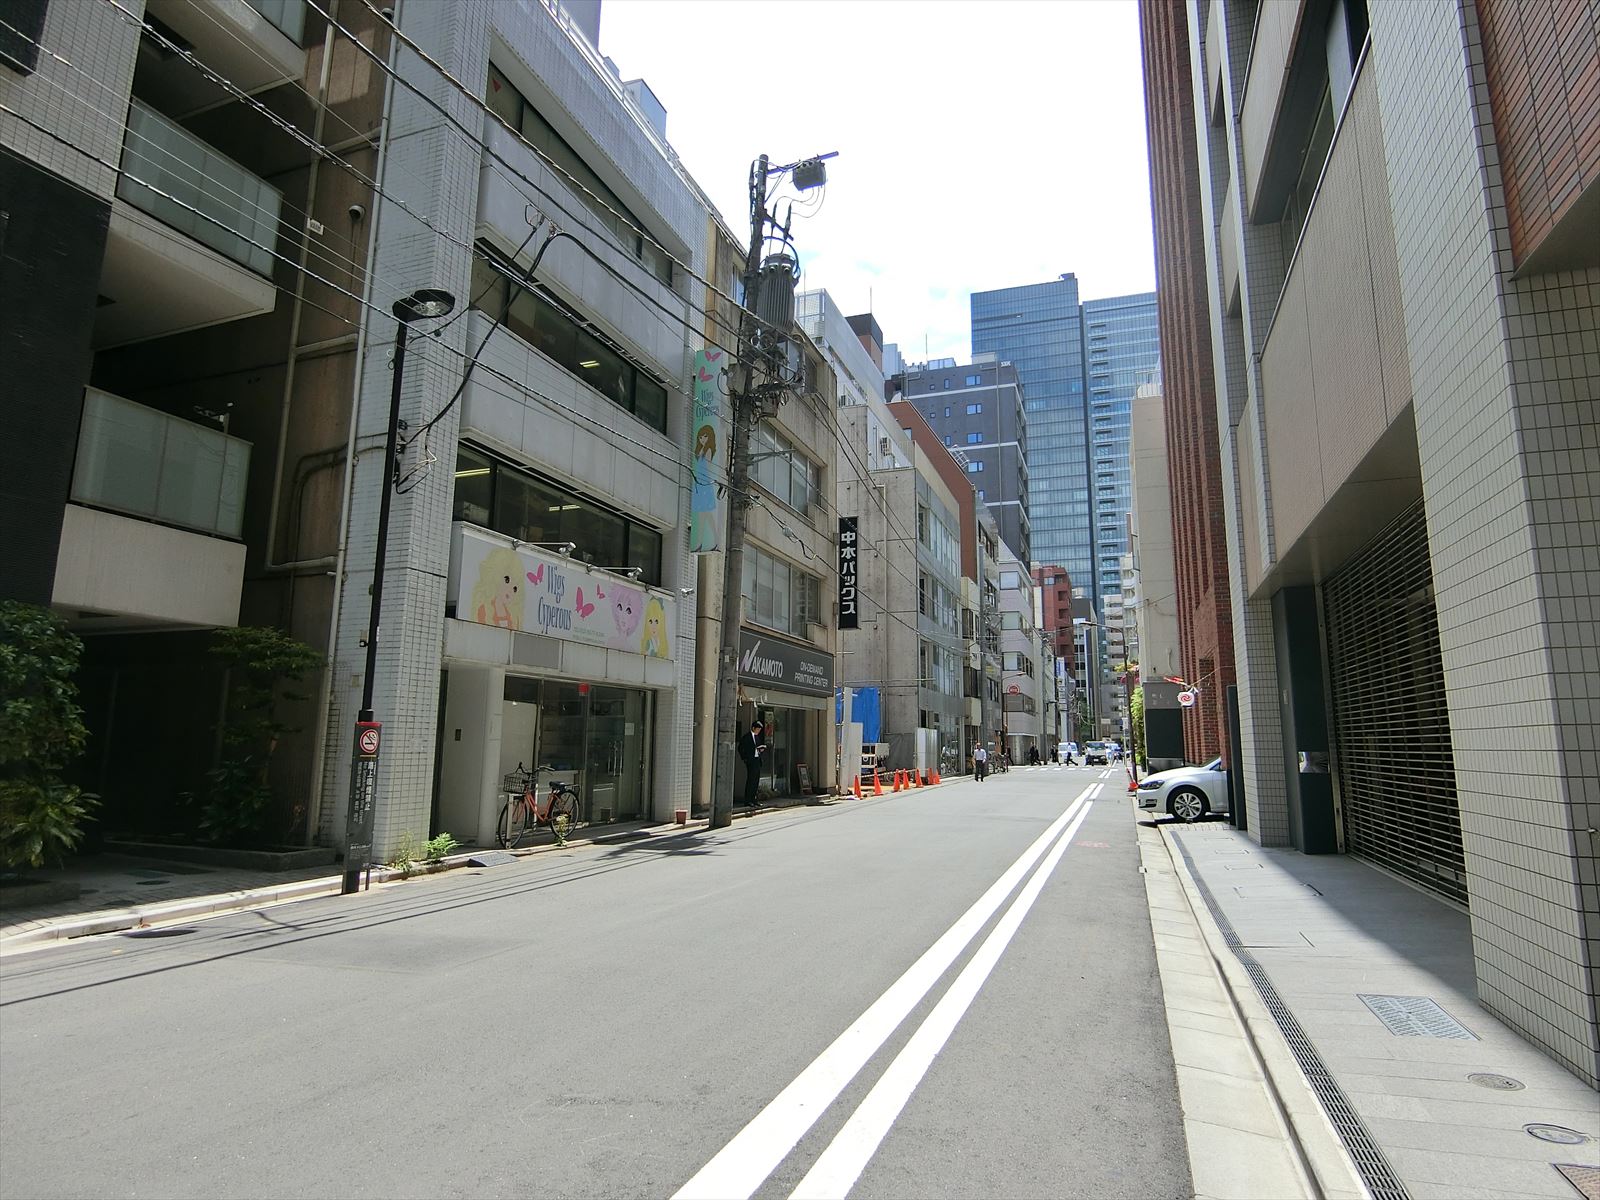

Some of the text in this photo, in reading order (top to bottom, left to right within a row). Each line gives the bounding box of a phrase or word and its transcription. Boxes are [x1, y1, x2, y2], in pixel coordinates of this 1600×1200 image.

[547, 565, 565, 604] Wigs
[841, 531, 856, 614] 中本パックス
[794, 672, 829, 688] PRINTING CENTER
